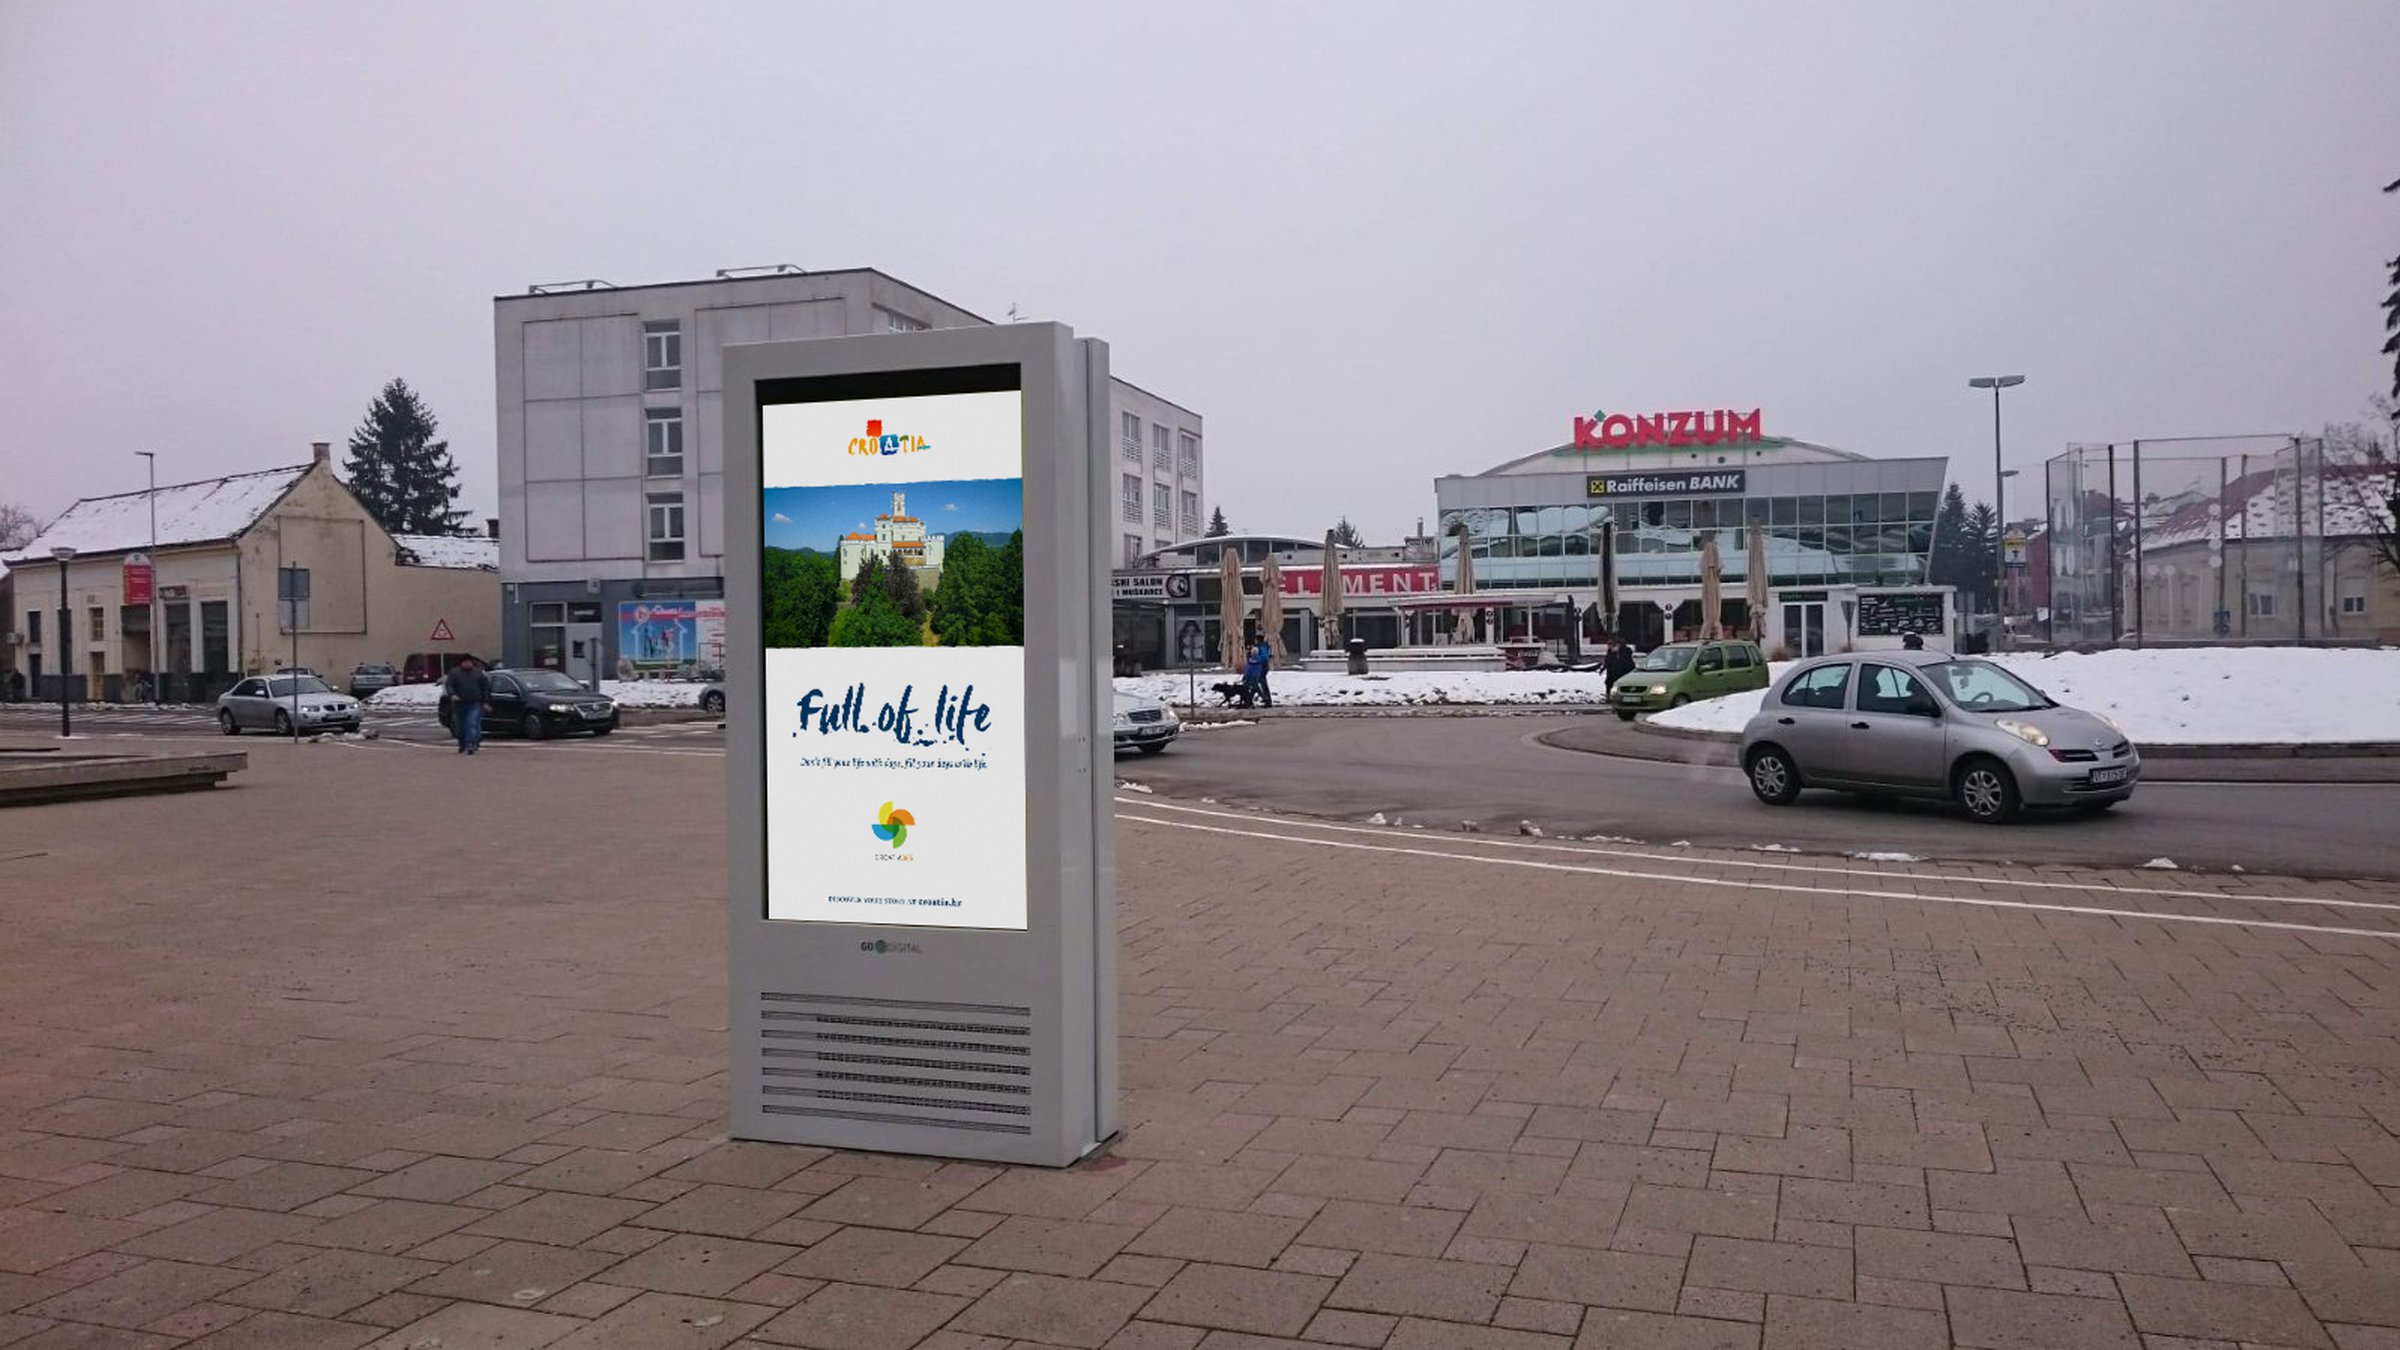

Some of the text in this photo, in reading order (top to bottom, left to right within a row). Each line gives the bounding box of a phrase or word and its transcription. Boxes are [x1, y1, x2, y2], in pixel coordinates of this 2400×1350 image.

[1574, 408, 1761, 451] KONZUM
[848, 434, 931, 455] CROATIA
[1607, 474, 1740, 494] Raiffeisen BANK
[1133, 577, 1163, 587] SALON
[1280, 572, 1436, 595] LMENT
[797, 682, 991, 745] Full of life
[918, 896, 963, 907] croatia.hr
